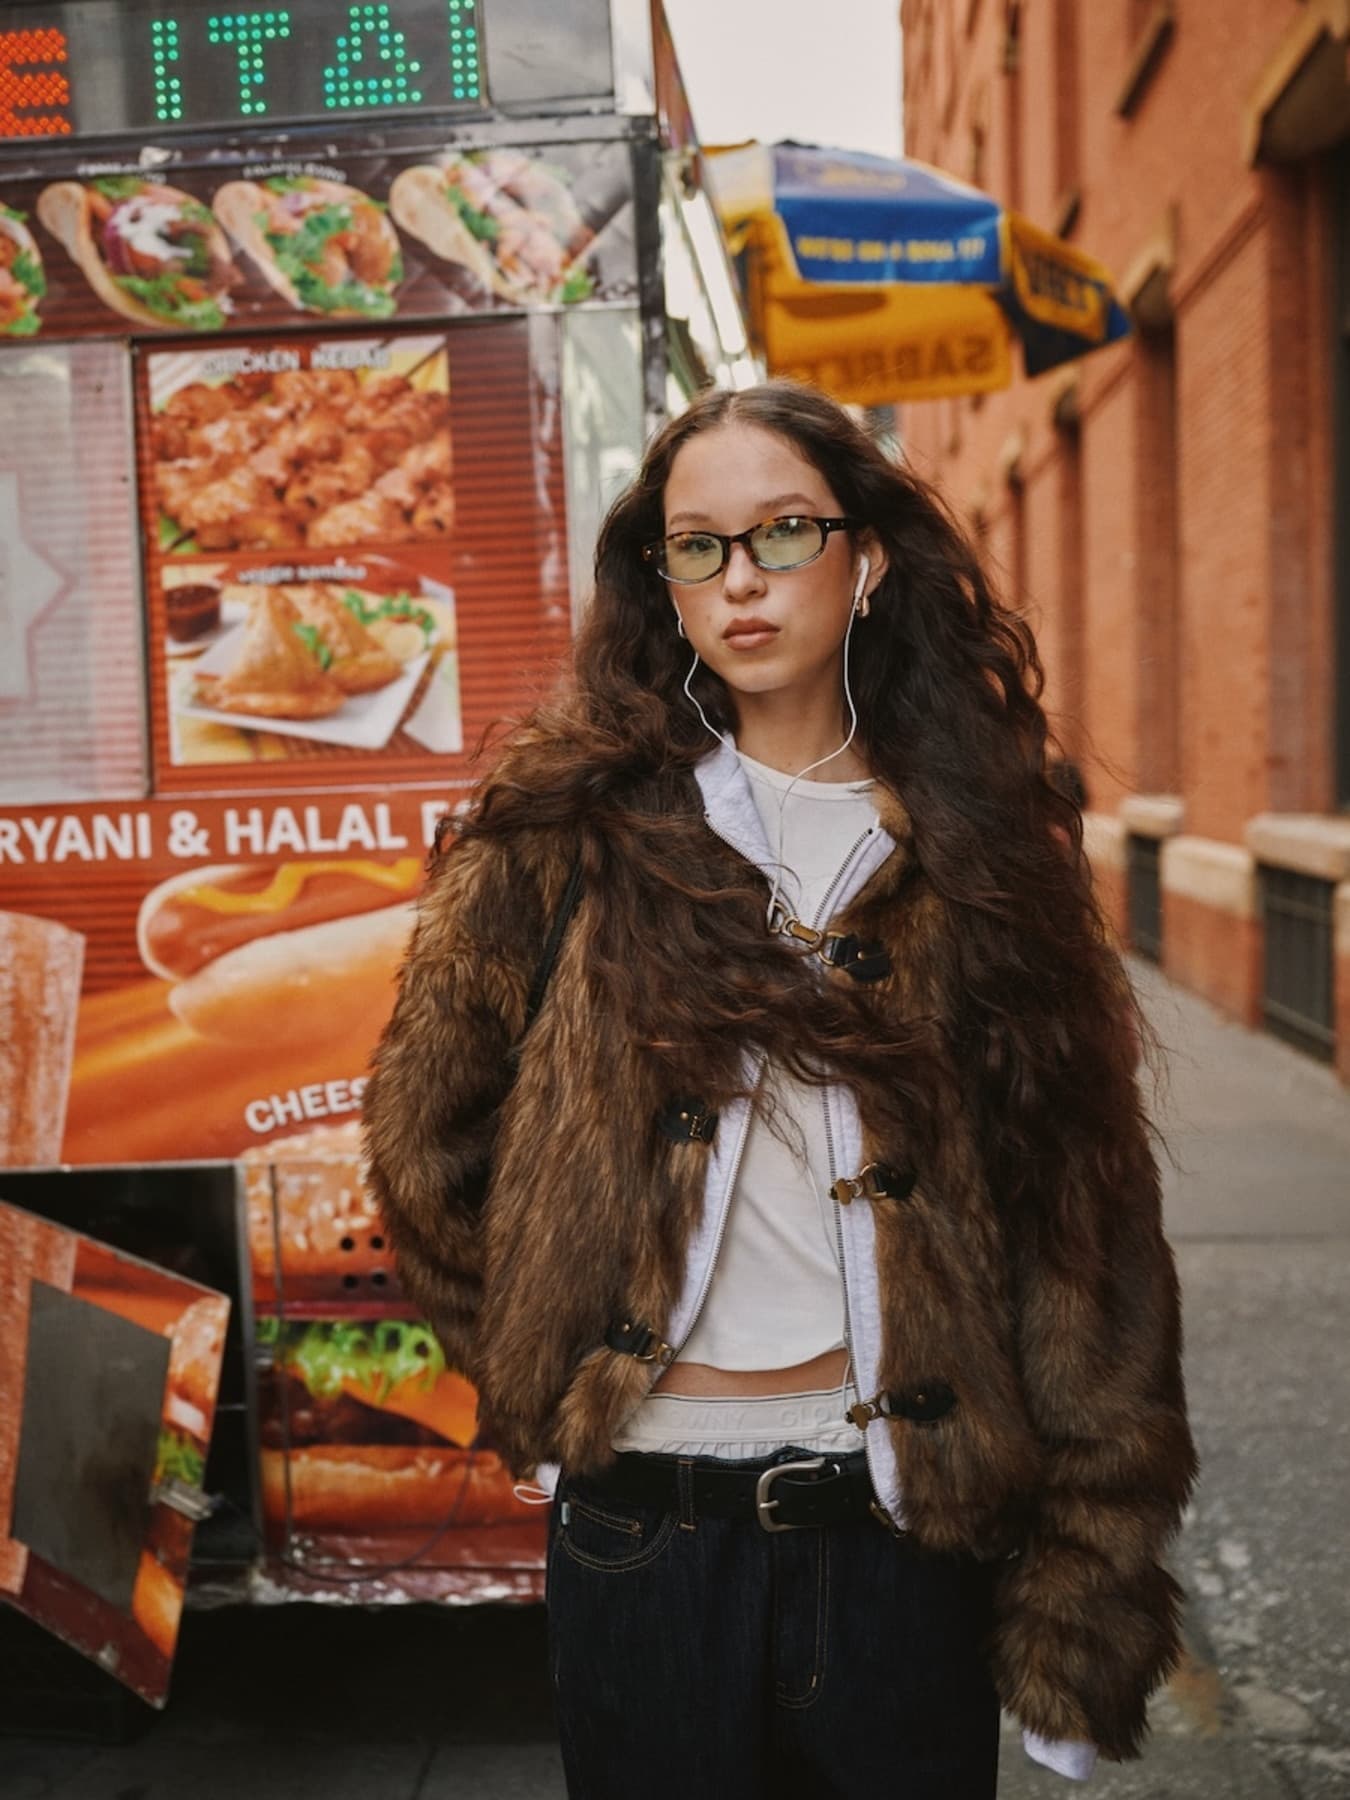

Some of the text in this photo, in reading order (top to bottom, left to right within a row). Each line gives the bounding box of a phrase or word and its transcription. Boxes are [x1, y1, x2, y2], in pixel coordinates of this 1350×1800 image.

[0, 799, 473, 864] RYANI & HALAL F
